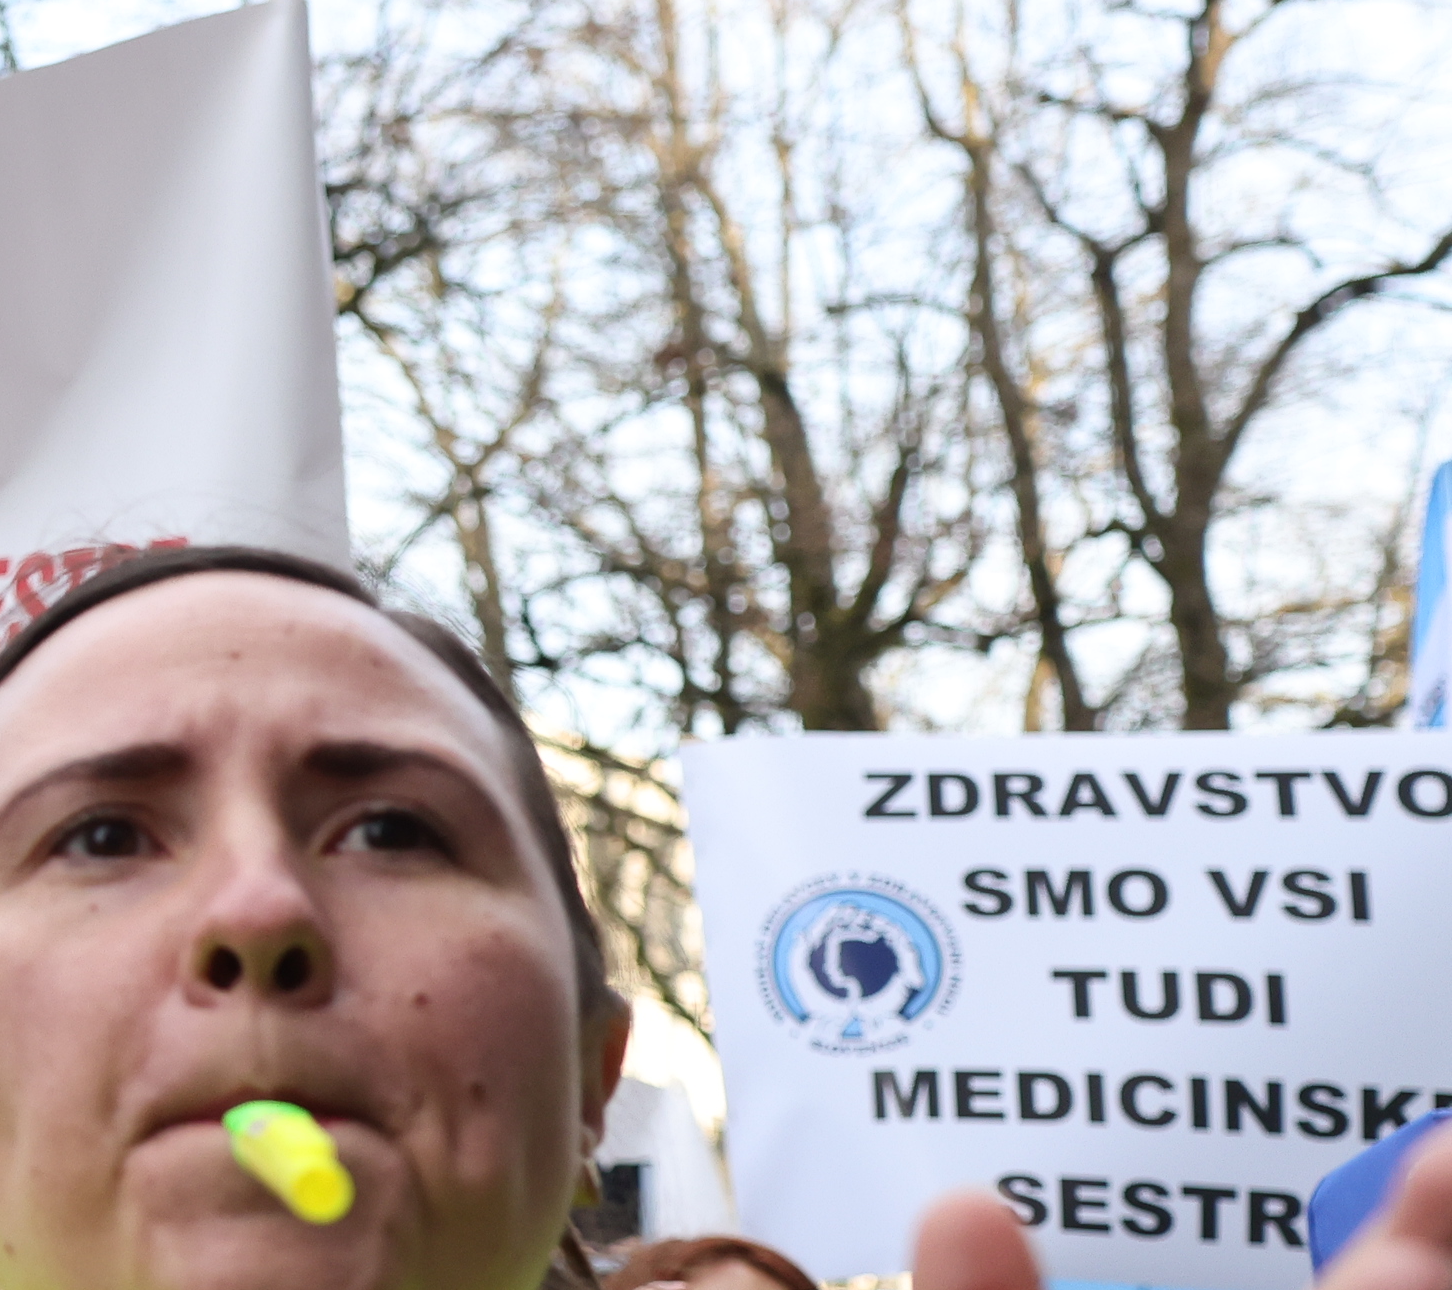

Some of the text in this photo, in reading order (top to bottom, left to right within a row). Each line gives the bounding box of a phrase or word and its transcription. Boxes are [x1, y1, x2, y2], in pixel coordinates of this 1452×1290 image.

[861, 770, 1452, 819] ZDRAVSTVO
[961, 867, 1373, 923] SMO VSI
[1051, 969, 1289, 1026] TUDI
[872, 1069, 1452, 1140] MEDICINSK
